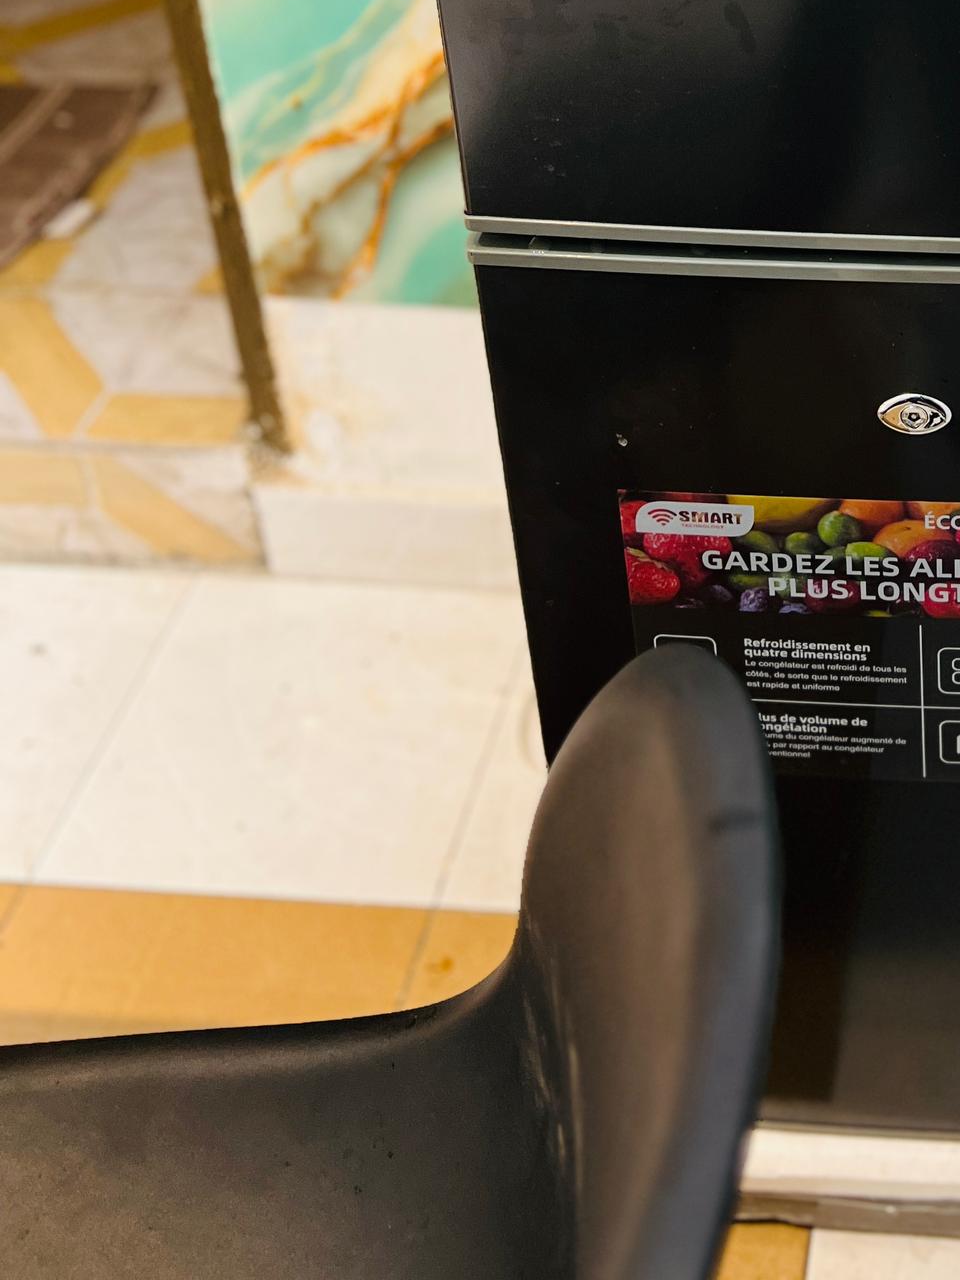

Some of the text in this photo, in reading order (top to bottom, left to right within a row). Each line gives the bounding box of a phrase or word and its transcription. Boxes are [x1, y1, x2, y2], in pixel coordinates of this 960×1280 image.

[678, 510, 743, 525] SMART
[701, 550, 835, 576] GARDEZ
[845, 556, 900, 577] LES
[768, 577, 850, 600] PLUS
[743, 638, 871, 653] Refroidissement en
[744, 649, 867, 661] quatre dimensions
[758, 660, 810, 670] congélateur
[827, 663, 858, 671] refroidi
[774, 671, 786, 679] de
[811, 674, 828, 682] que
[840, 675, 907, 684] refroidissement
[762, 681, 790, 690] rapide
[791, 682, 800, 690] et
[802, 683, 840, 692] uniforme
[758, 712, 868, 727] lus de volume de
[761, 723, 828, 733] ngélation
[798, 733, 849, 743] congélateur
[789, 742, 820, 751] rapport
[834, 745, 885, 754] congélateur
